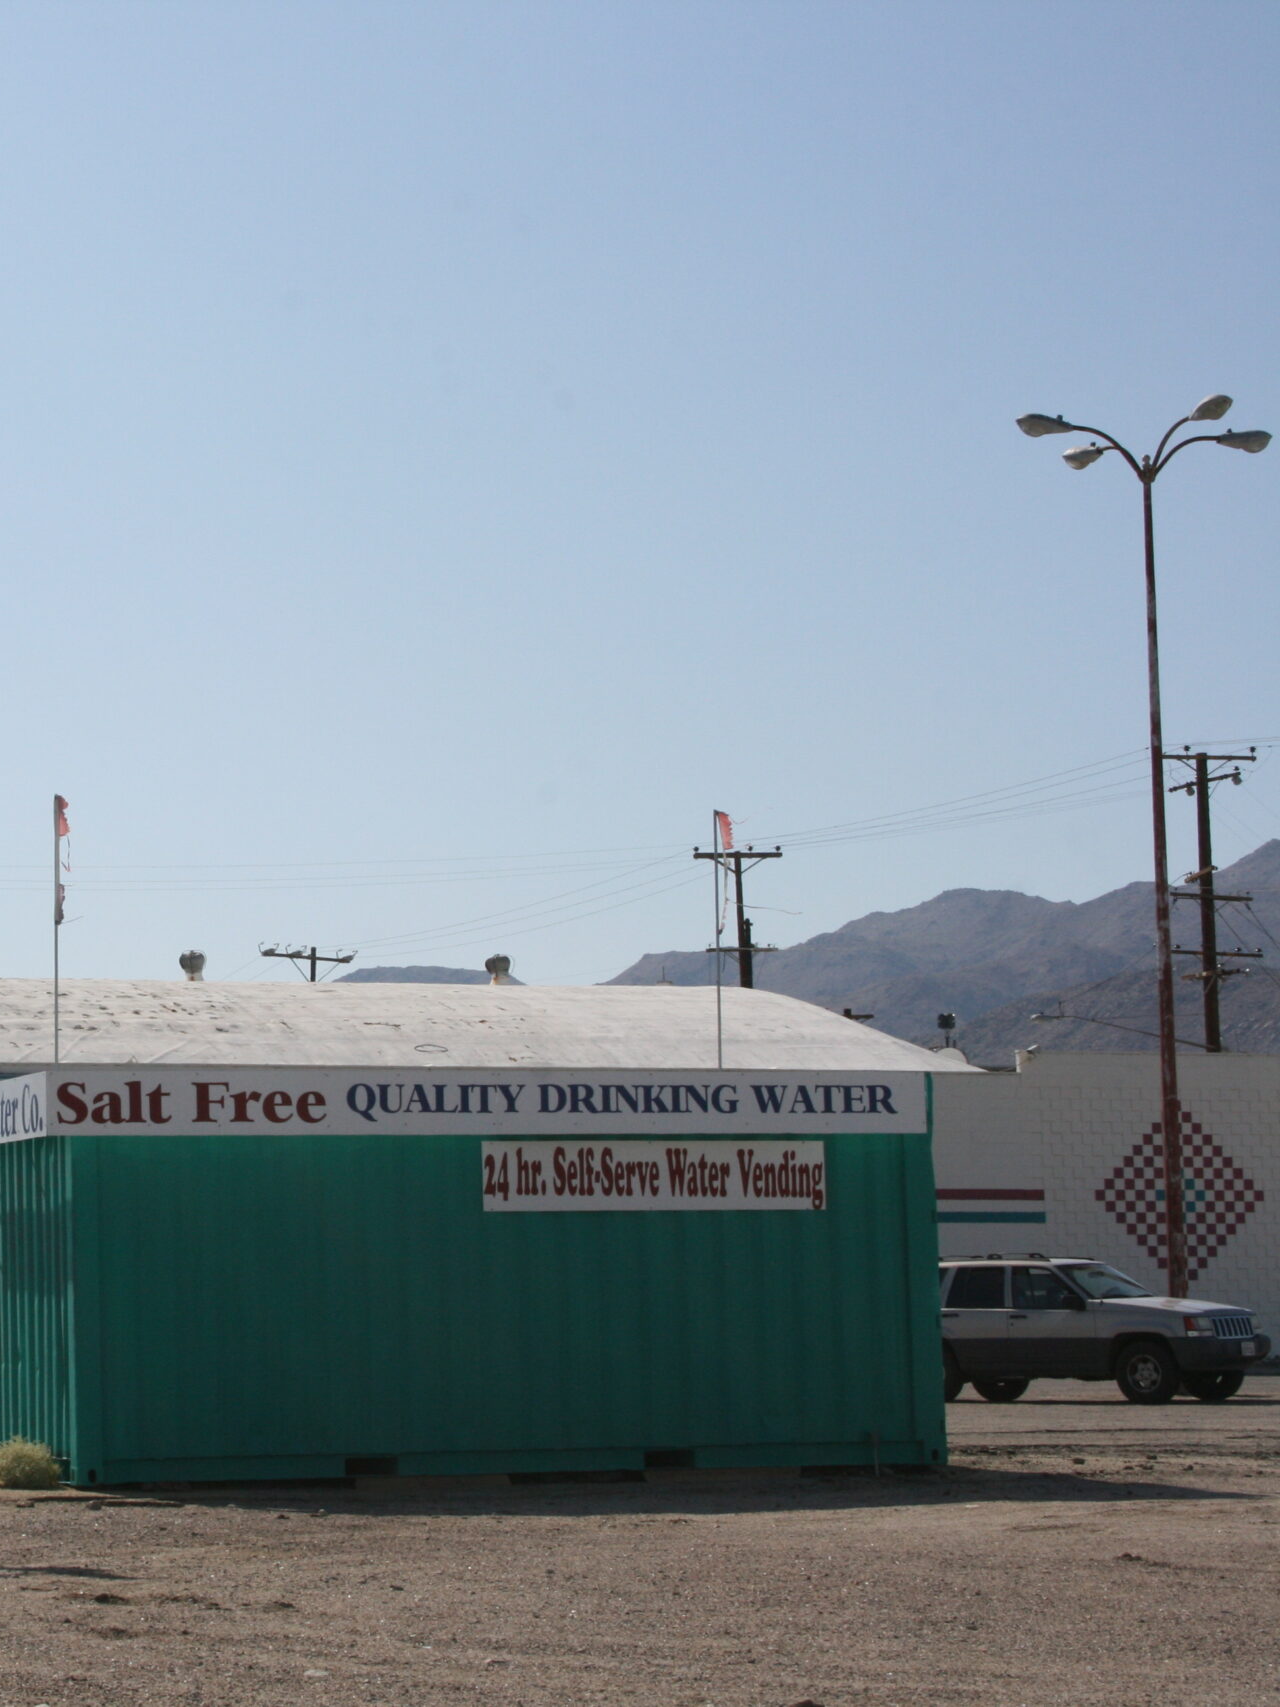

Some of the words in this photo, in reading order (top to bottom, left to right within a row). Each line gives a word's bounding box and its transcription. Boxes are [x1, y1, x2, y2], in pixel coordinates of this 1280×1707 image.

[22, 1084, 44, 1133] Co.
[57, 1081, 171, 1124] Salt
[191, 1082, 327, 1123] Free
[346, 1083, 526, 1122] QUALITY
[536, 1084, 739, 1114] DRINKING
[750, 1084, 898, 1114] WATER
[483, 1153, 509, 1201] 24
[516, 1148, 547, 1196] hr.
[553, 1147, 660, 1196] Self-Serve
[666, 1147, 730, 1197] Water
[737, 1150, 823, 1209] Vending
